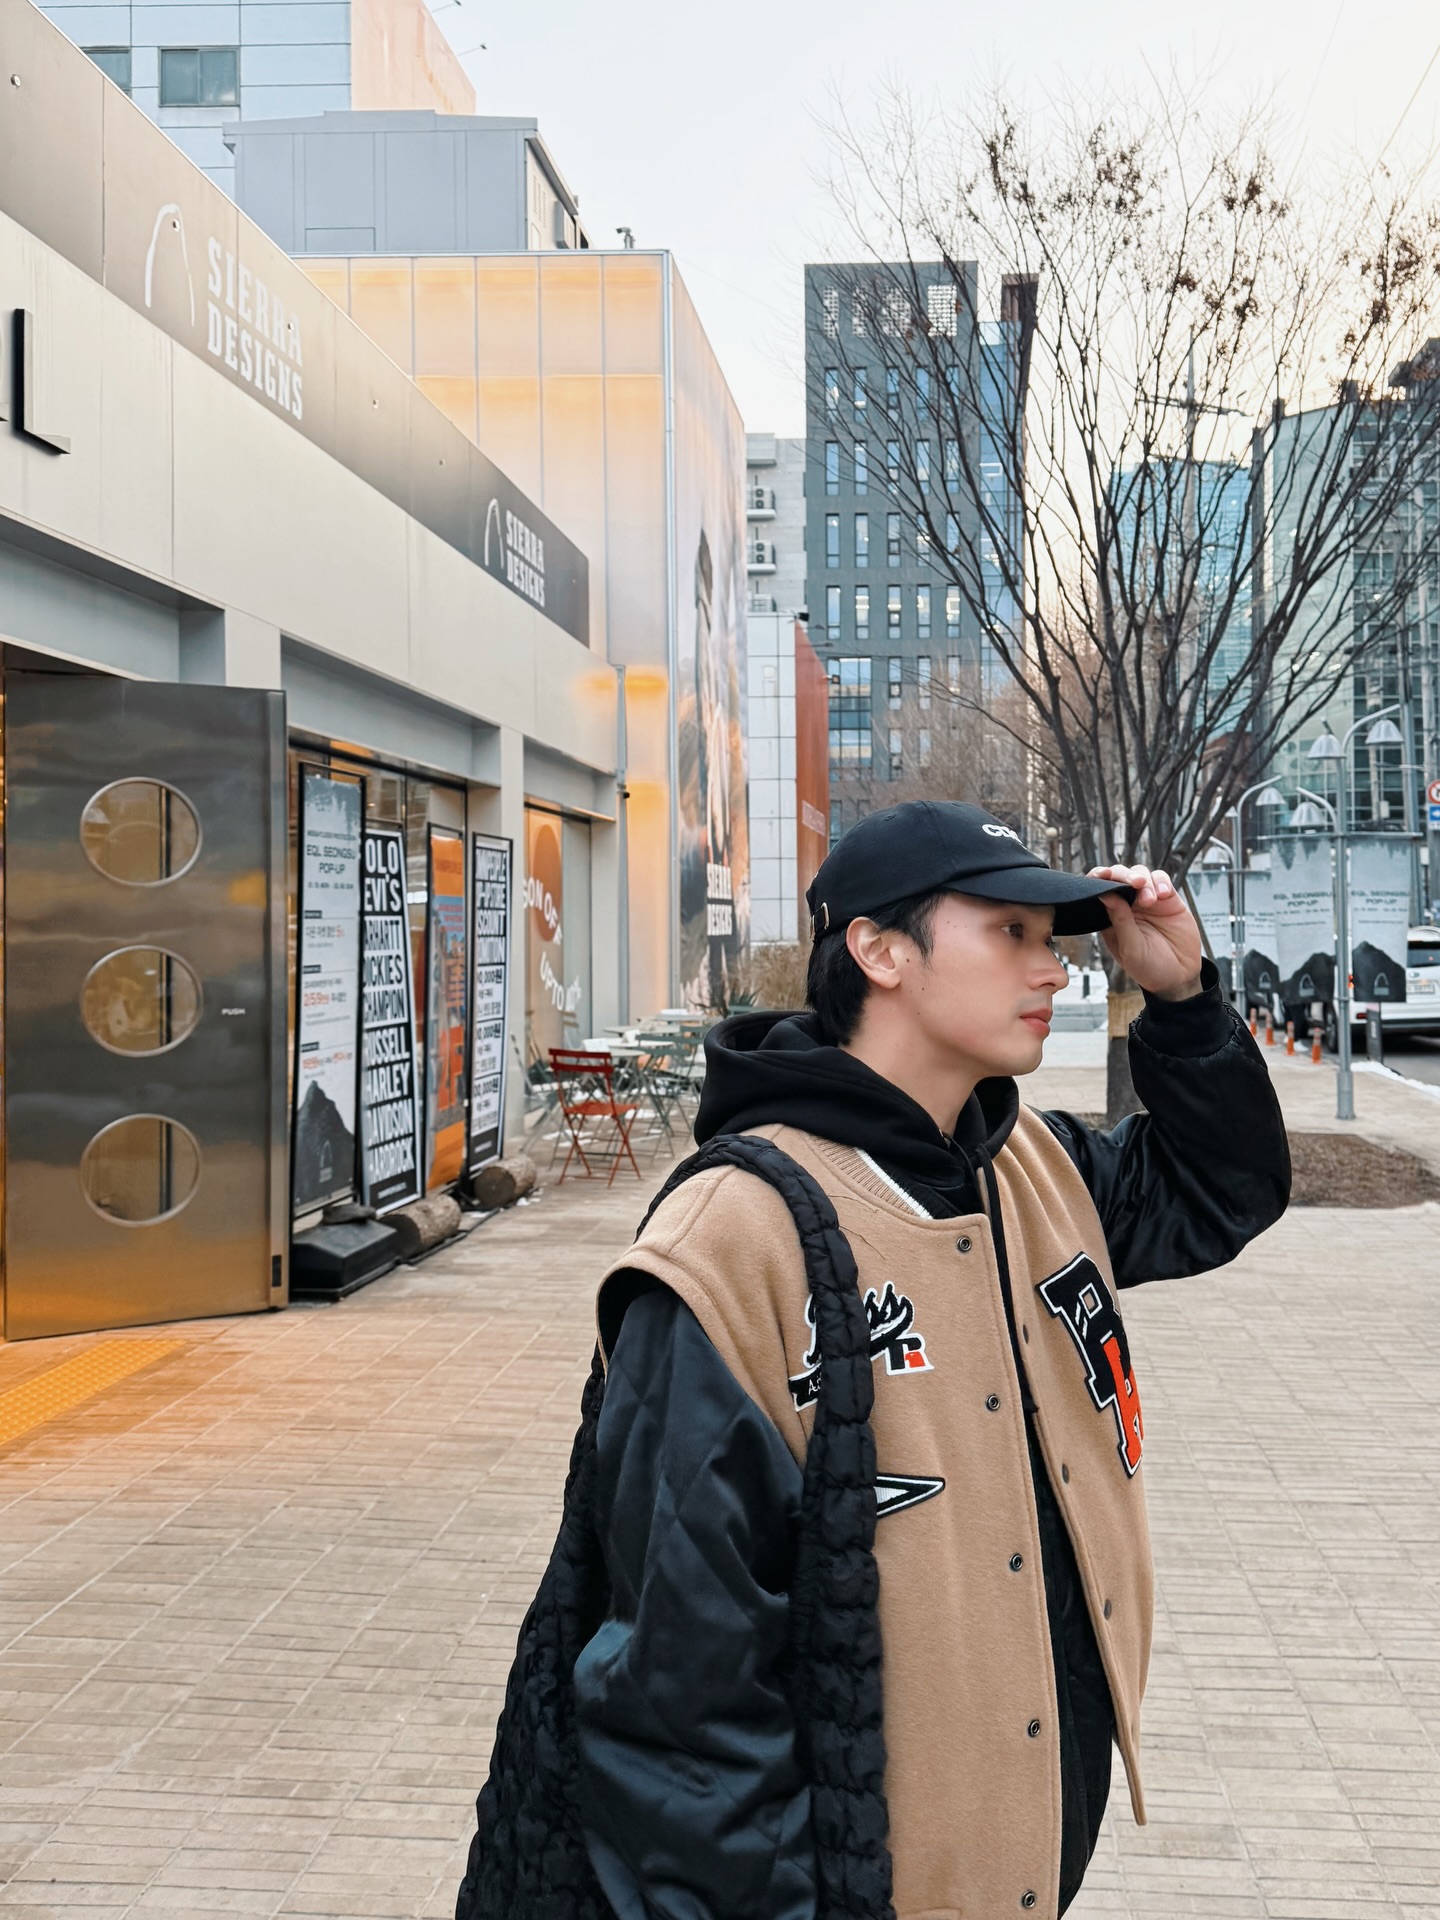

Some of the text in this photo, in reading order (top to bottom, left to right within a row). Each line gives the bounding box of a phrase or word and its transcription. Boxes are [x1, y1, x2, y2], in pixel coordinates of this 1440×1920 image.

[207, 235, 303, 367] SIERRA
[0, 307, 72, 456] L
[207, 299, 304, 421] DESIGNS
[506, 508, 545, 574] SIERRA
[506, 548, 545, 608] DESIGNS
[319, 861, 345, 874] POP-UP
[365, 837, 399, 875] OLO
[364, 874, 402, 912] EVI'S
[363, 919, 400, 951] ARHARTT
[221, 1007, 246, 1016] PUSH
